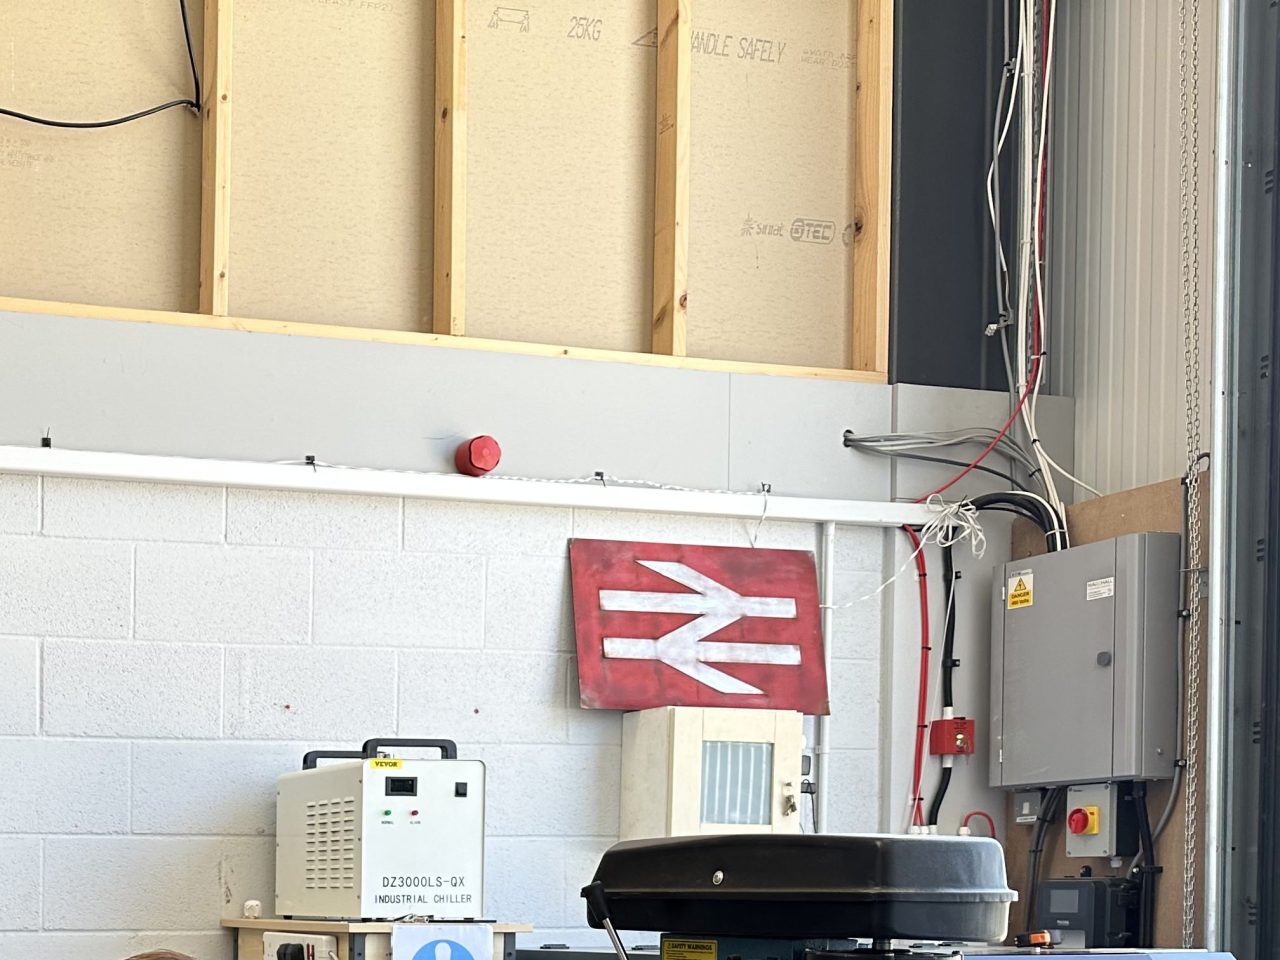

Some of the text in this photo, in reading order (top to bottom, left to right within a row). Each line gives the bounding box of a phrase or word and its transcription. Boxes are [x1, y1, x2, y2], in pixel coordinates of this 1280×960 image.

[566, 16, 603, 42] 25KG
[737, 36, 787, 63] SAFELY
[382, 876, 465, 888] DZ3000LS-QX
[374, 894, 472, 904] INDUSTRIAL CHILLER
